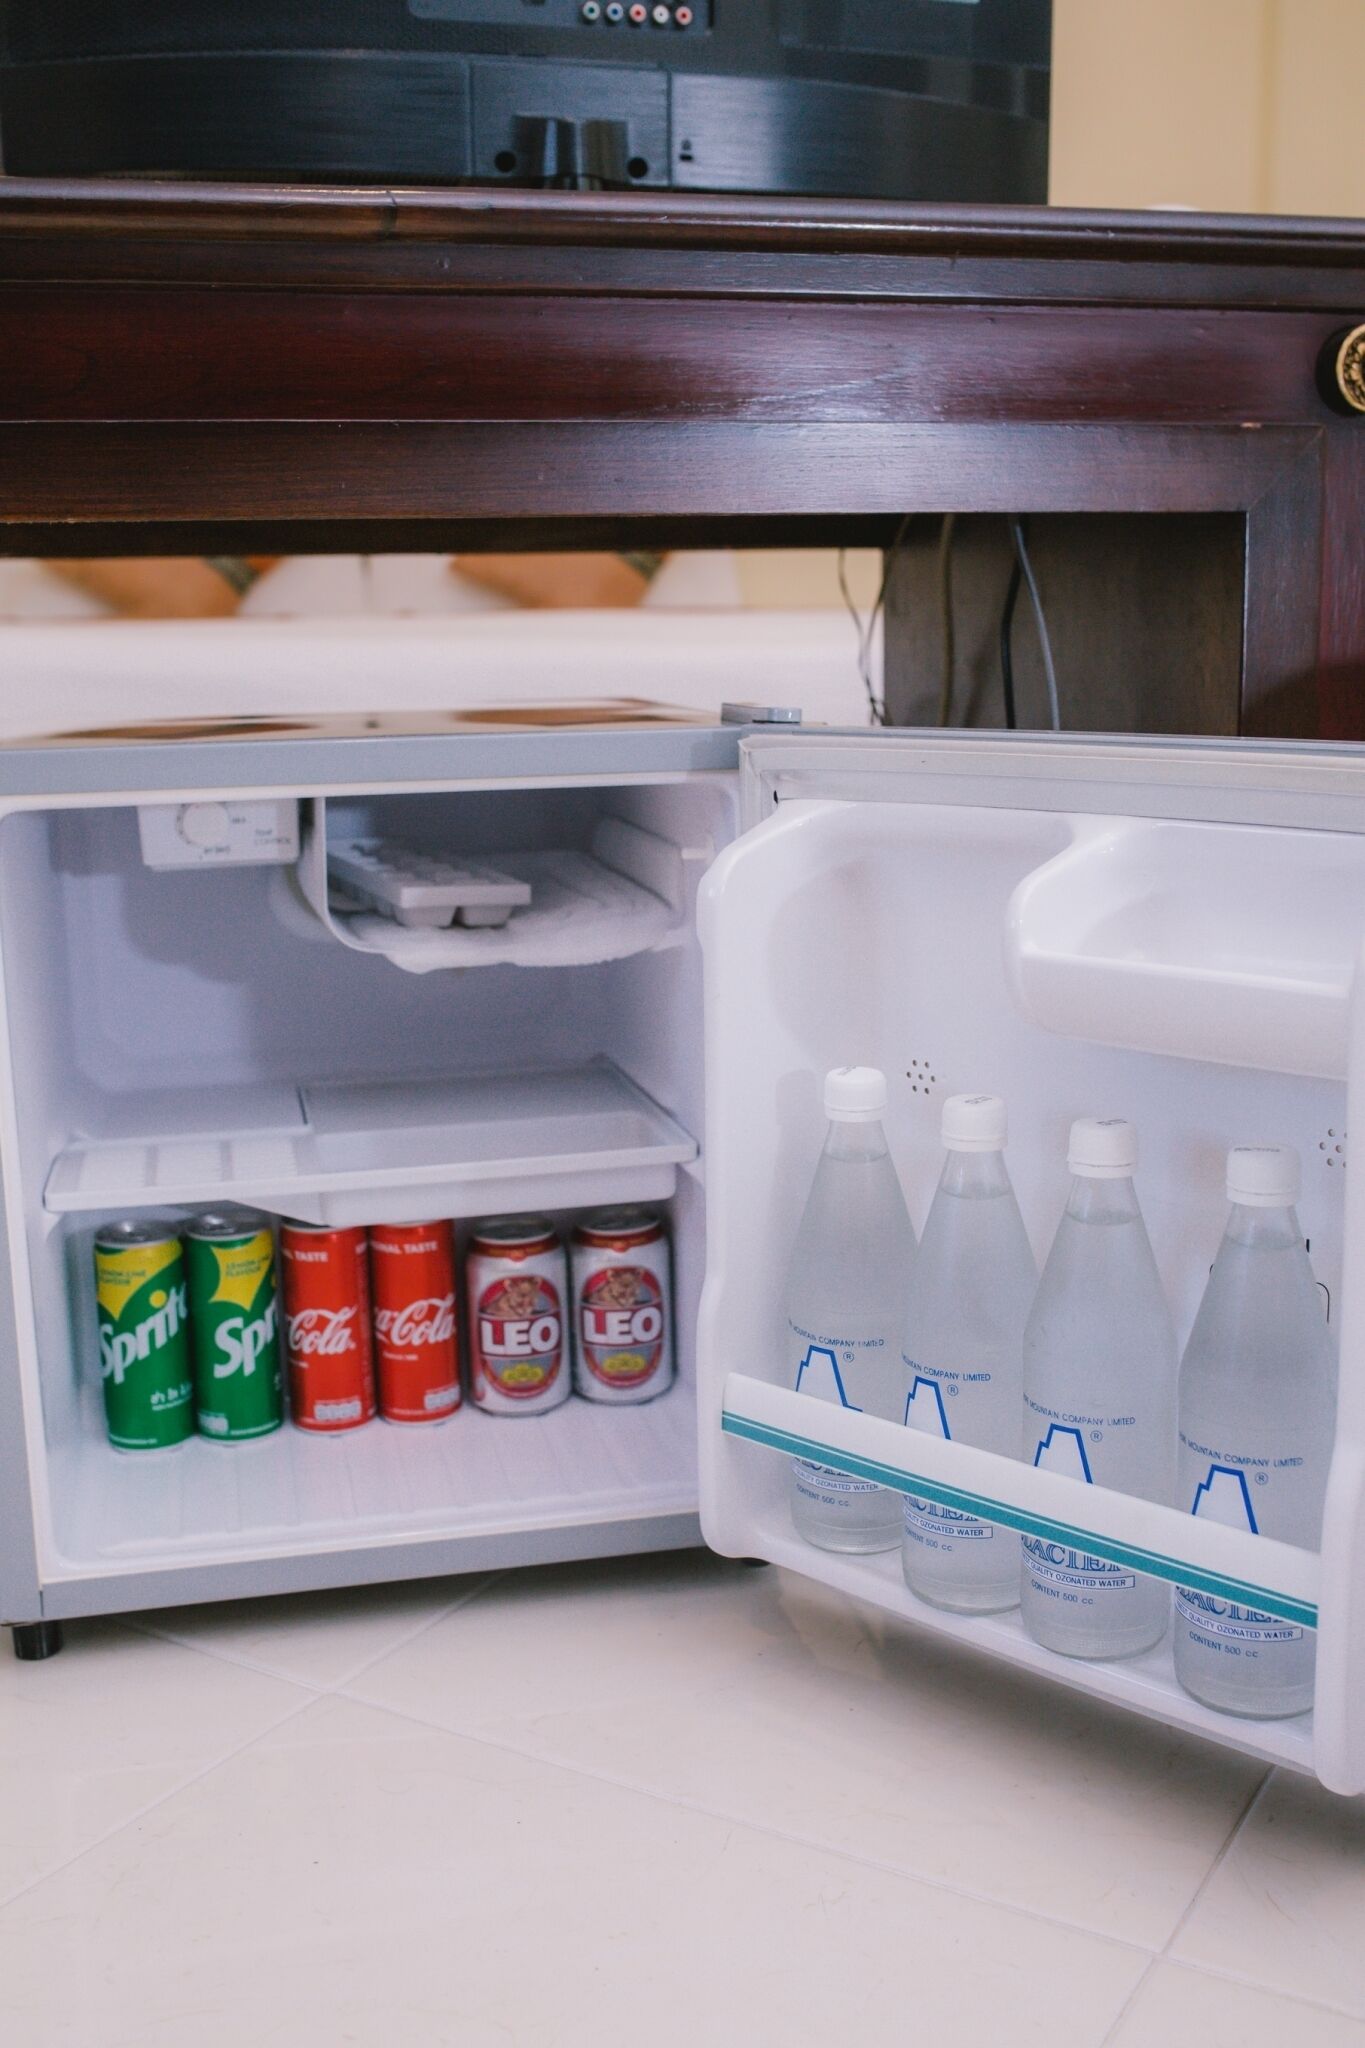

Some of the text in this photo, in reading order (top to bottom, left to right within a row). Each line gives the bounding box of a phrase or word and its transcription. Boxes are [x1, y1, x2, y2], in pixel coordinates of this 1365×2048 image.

[403, 1240, 438, 1254] TASTE
[294, 1250, 329, 1263] TASTE
[583, 1306, 663, 1345] LEO
[480, 1315, 560, 1356] LEO
[818, 1335, 855, 1347] COMPANY
[924, 1366, 960, 1380] COMPANY
[963, 1373, 991, 1382] LIMITED
[1062, 1413, 1104, 1426] COMPANY
[1107, 1416, 1136, 1426] LIMITED
[1187, 1438, 1222, 1460] MOUNTAIN
[1224, 1453, 1270, 1467] COMPANY
[1273, 1456, 1304, 1468] LIMITED
[815, 1478, 852, 1491] OZONATED
[853, 1483, 879, 1491] WATER
[920, 1519, 954, 1535] OZONATED
[956, 1528, 984, 1537] WATER
[1055, 1571, 1096, 1587] OZONATED
[1099, 1579, 1126, 1588] WATER
[1031, 1579, 1060, 1599] CONTENT
[1063, 1592, 1078, 1603] 500
[1188, 1610, 1294, 1639] QUALITY OZONATED WATER
[1189, 1631, 1222, 1651] CONTENT
[1224, 1646, 1241, 1656] 500
